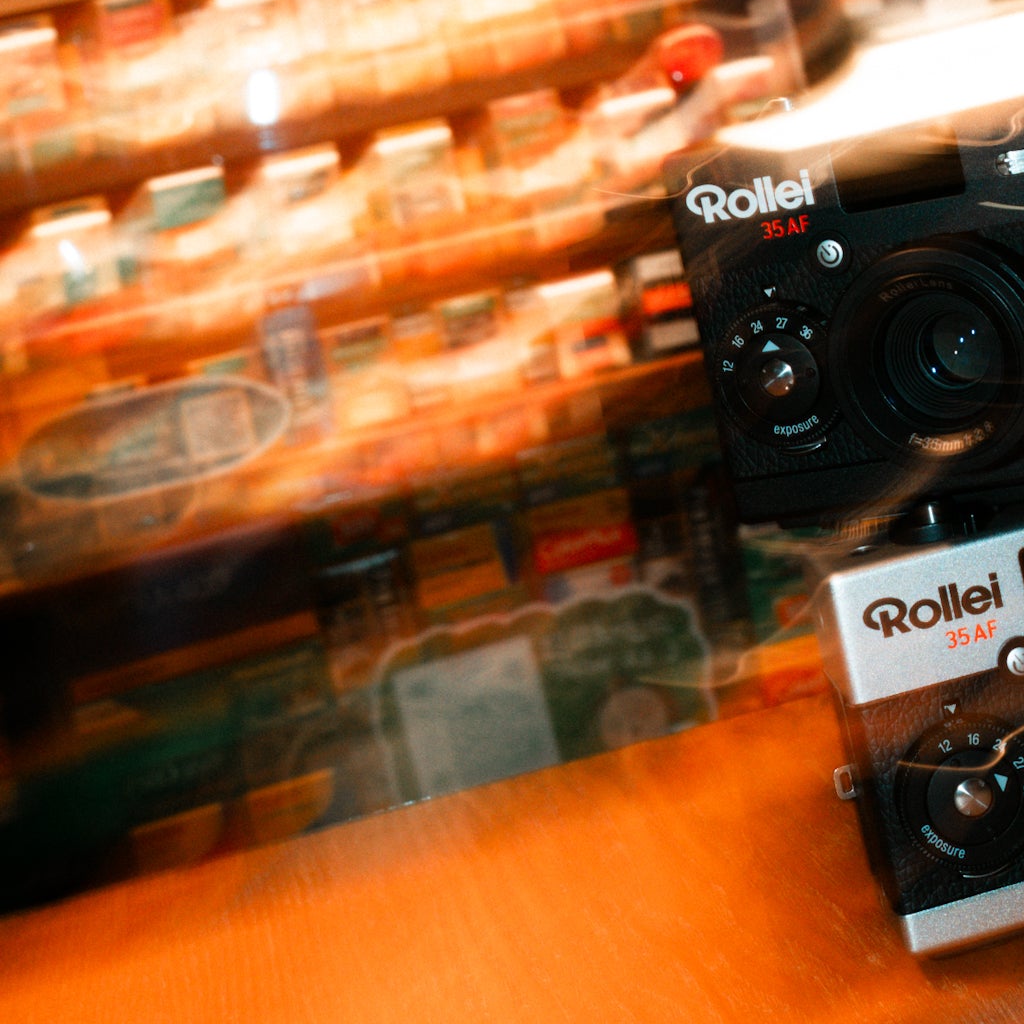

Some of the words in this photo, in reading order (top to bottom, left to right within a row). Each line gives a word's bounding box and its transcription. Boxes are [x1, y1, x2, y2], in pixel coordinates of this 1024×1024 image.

[685, 169, 815, 223] Rollei
[750, 319, 764, 335] 24
[776, 316, 788, 329] 27
[799, 325, 814, 340] 36
[731, 334, 745, 349] 16
[722, 359, 734, 373] 12
[773, 414, 820, 438] exposure
[862, 572, 1004, 639] Rollei
[938, 739, 953, 754] 12
[967, 733, 980, 746] 16
[920, 823, 967, 860] exposure
